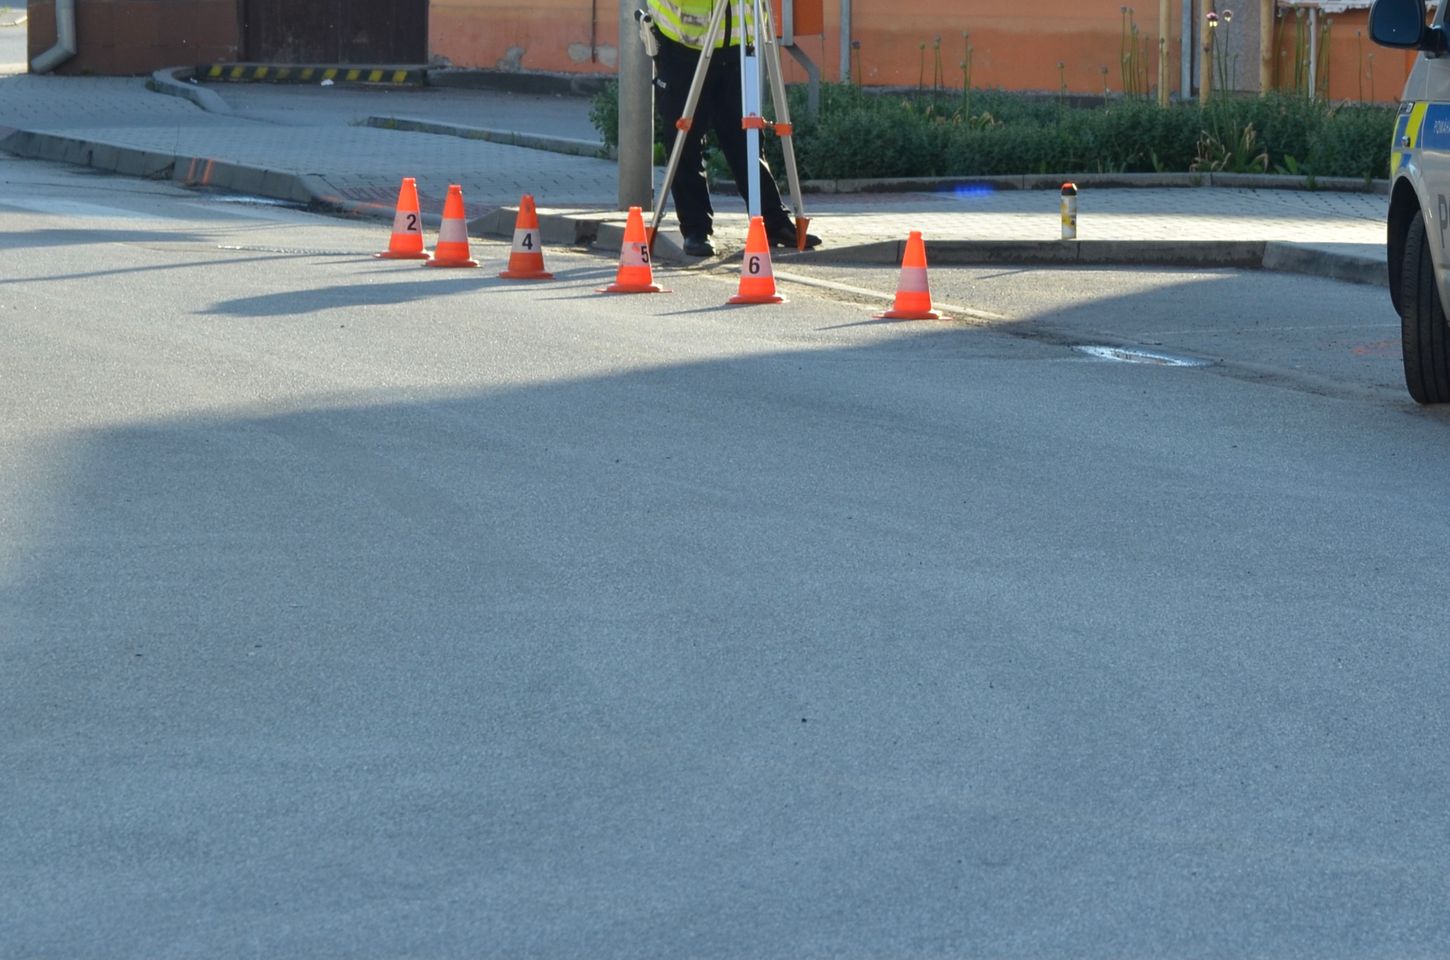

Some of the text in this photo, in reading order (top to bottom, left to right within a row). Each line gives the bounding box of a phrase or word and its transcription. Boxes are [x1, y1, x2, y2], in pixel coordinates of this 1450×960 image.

[406, 213, 417, 231] 2
[521, 233, 534, 250] 4
[641, 245, 649, 263] 5
[749, 256, 760, 275] 6
